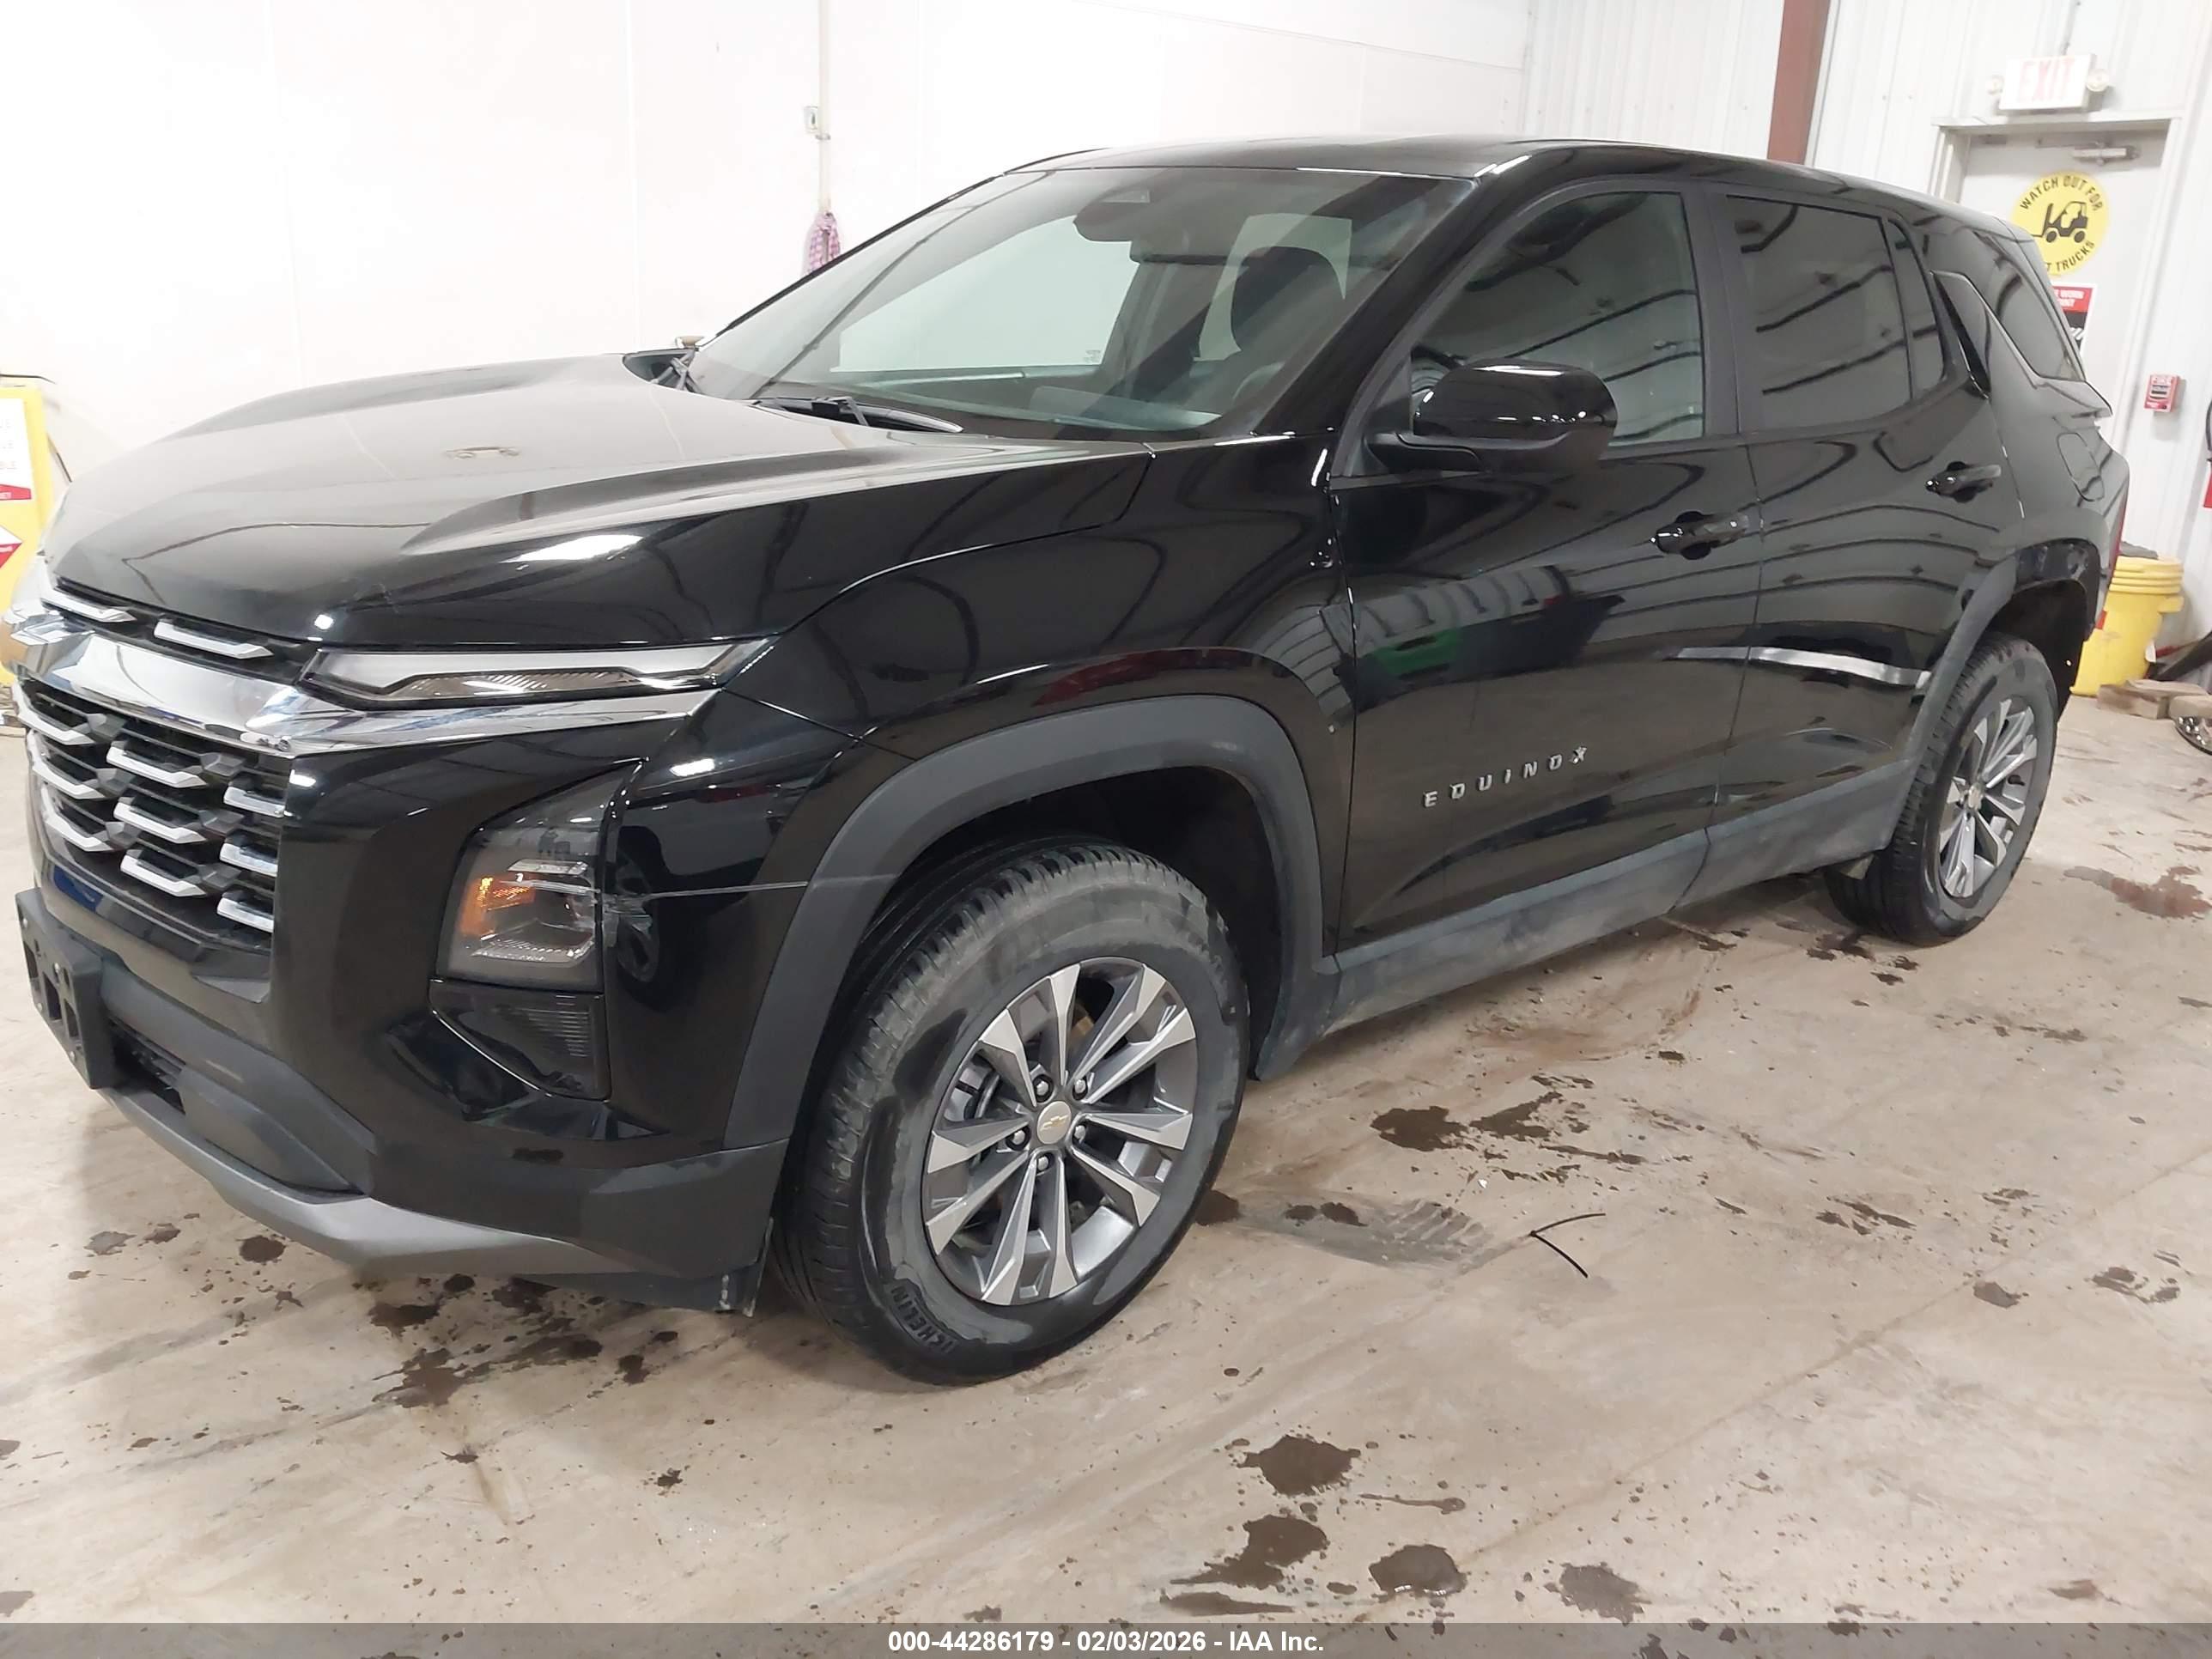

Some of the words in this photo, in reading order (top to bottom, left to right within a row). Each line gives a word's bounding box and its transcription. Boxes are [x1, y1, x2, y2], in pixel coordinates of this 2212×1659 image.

[2015, 58, 2075, 103] EXIT
[2020, 176, 2058, 210] WATCH
[2063, 175, 2087, 191] OUT
[2085, 187, 2103, 211] FOR
[2056, 240, 2094, 271] TRUCKS
[1423, 745, 1587, 807] EQUINOX
